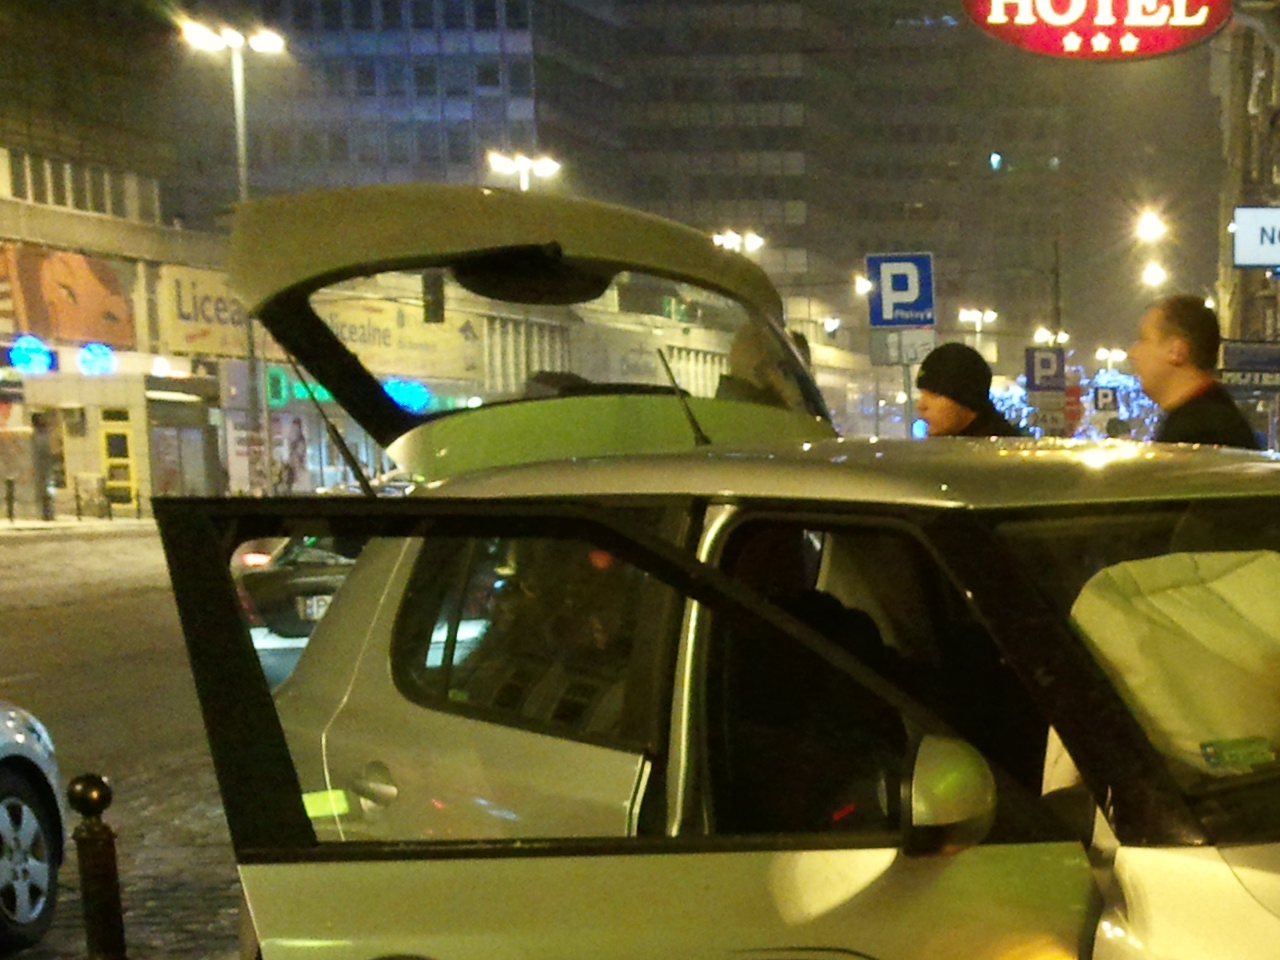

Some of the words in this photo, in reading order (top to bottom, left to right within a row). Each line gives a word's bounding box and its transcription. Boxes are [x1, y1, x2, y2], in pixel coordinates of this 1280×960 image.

[880, 262, 919, 320] P
[1034, 350, 1057, 385] P
[1098, 389, 1114, 409] P
